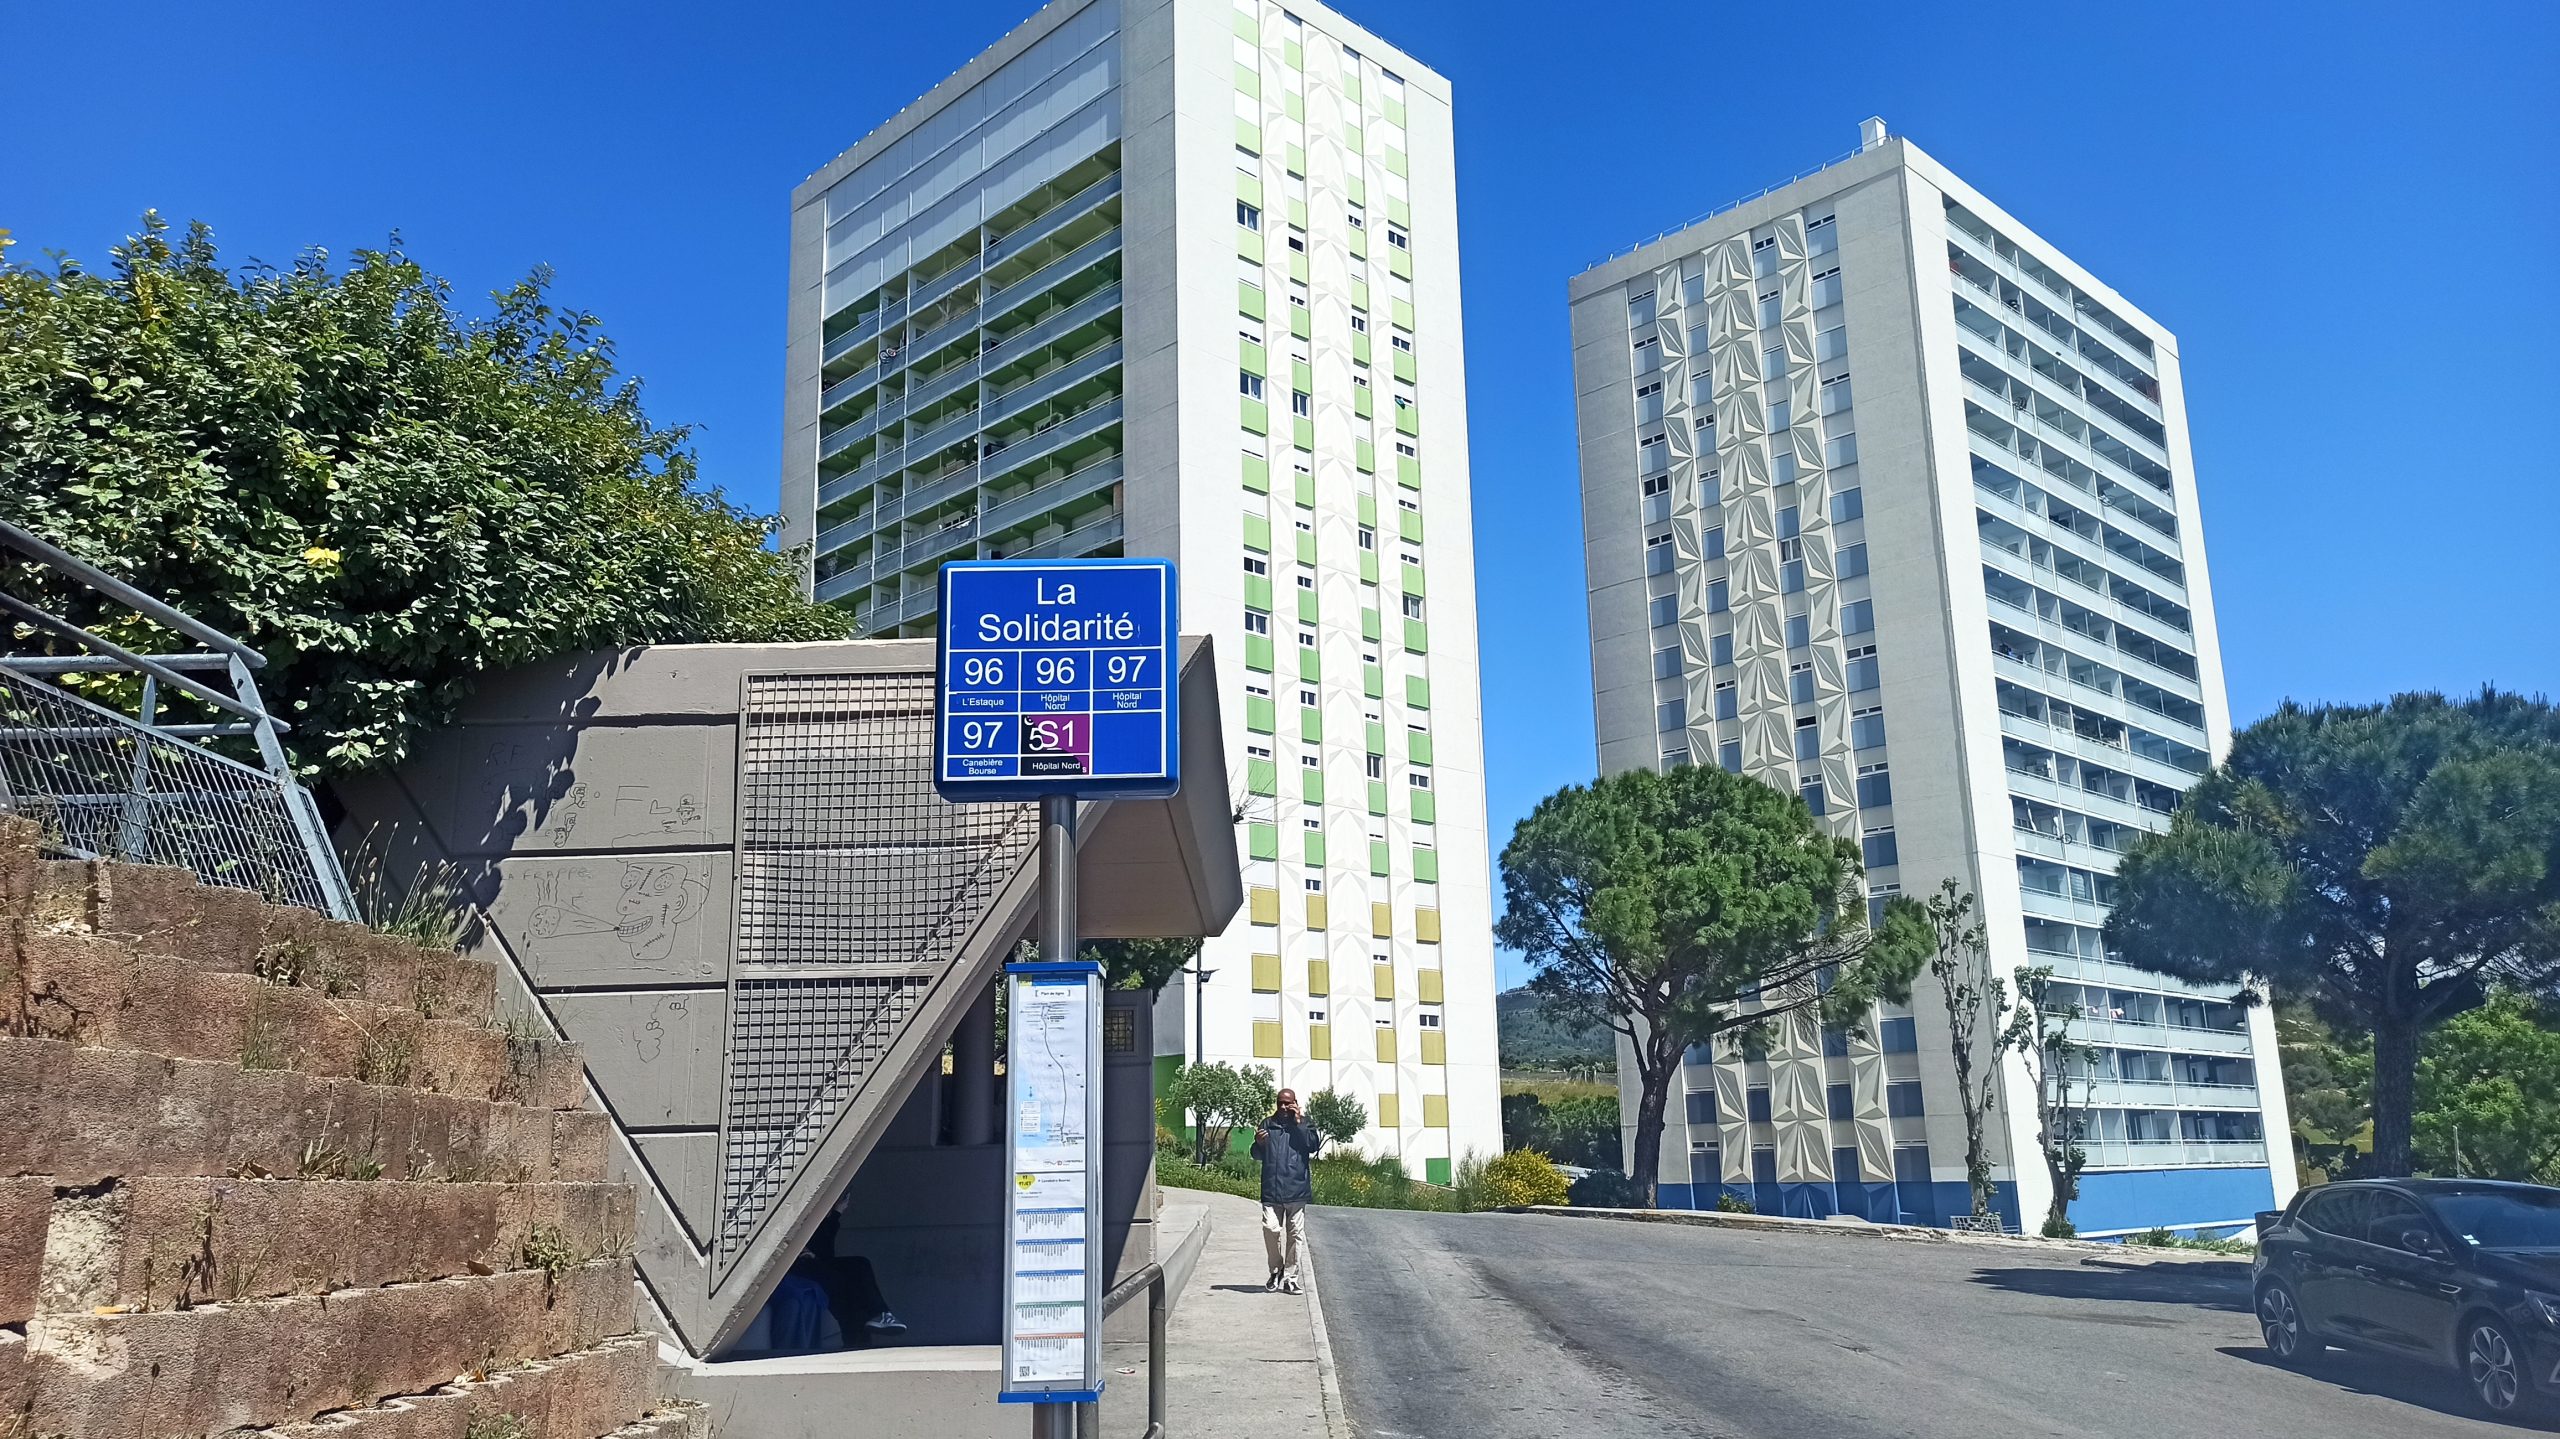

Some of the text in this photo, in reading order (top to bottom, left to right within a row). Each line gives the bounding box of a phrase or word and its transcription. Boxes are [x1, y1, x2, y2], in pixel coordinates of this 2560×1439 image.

[1037, 577, 1076, 605] La
[978, 611, 1134, 642] Solidarité
[964, 657, 1004, 685] 96
[1036, 657, 1075, 685] 96
[1107, 655, 1147, 684] 97
[1040, 693, 1070, 703] Hôpital
[1112, 691, 1142, 702] Hôpital
[962, 697, 1005, 708] L'Estaque
[1045, 702, 1066, 710] Nord
[1116, 700, 1138, 709] Nord
[963, 721, 1003, 749] 97
[962, 758, 1003, 767] Canebière
[1032, 761, 1081, 771] Hôpital Nord
[968, 767, 997, 775] Bourse
